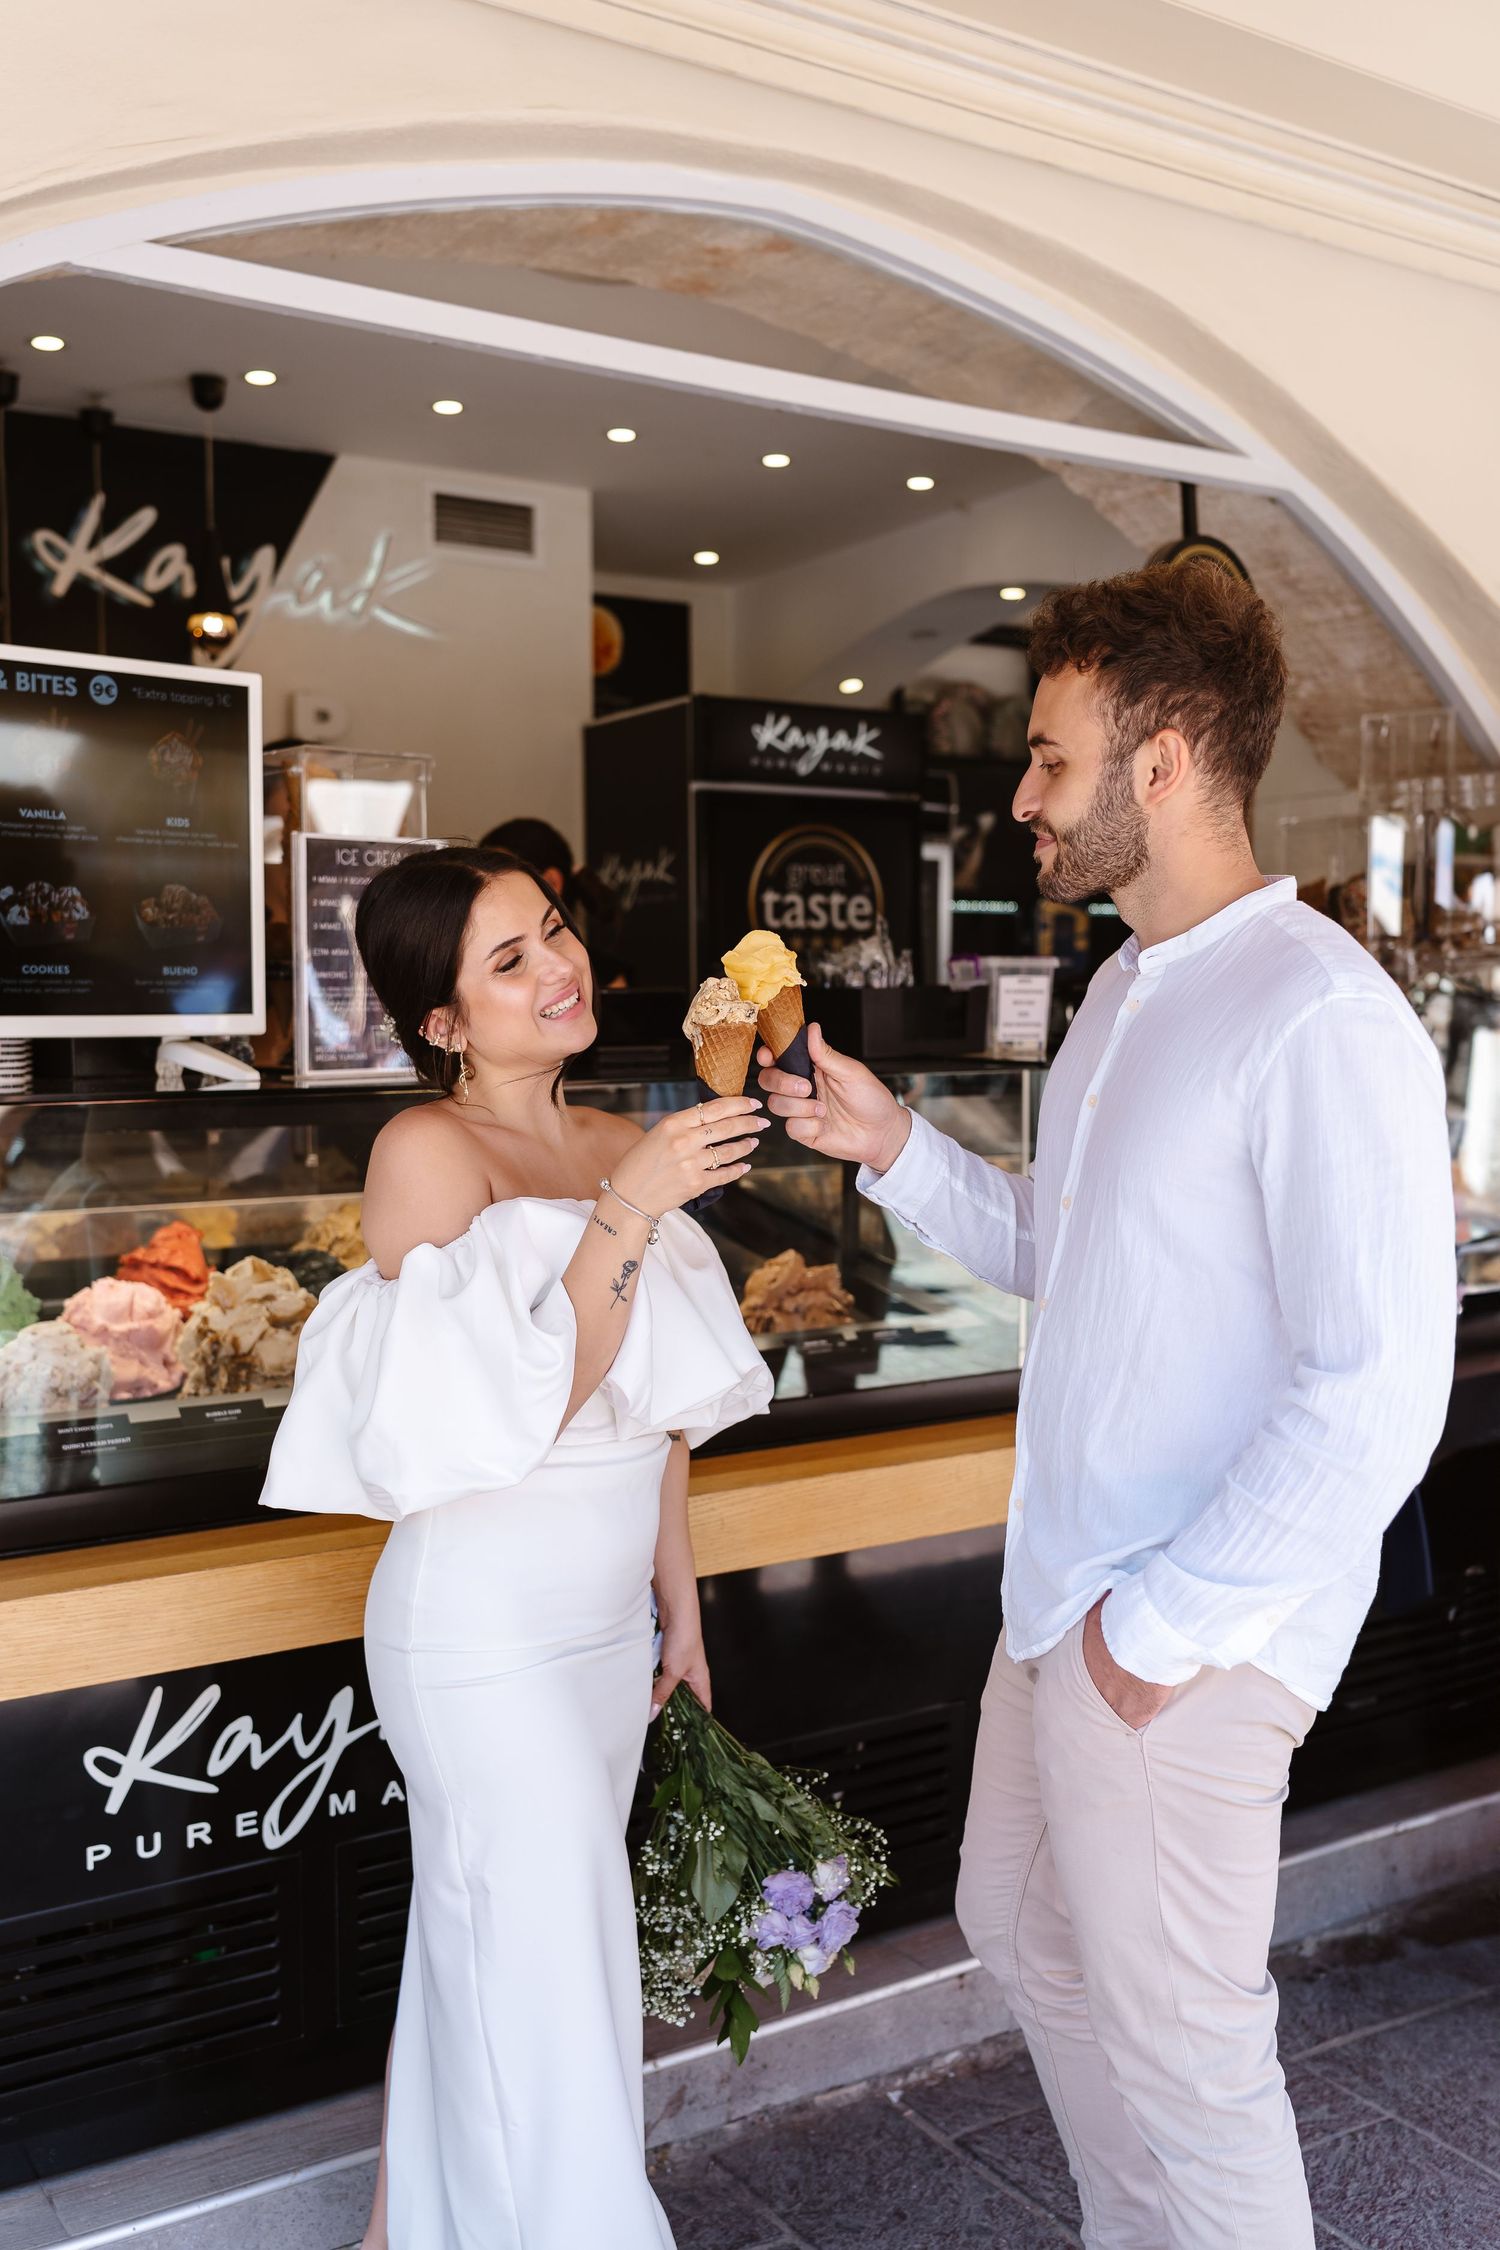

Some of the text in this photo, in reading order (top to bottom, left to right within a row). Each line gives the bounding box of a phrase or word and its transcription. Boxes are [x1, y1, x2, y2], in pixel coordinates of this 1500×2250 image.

[15, 671, 78, 697] BITES
[92, 682, 116, 698] 9€
[750, 711, 884, 776] Kayak
[19, 807, 67, 821] VANILLA
[165, 816, 191, 829] KIDS
[335, 848, 409, 867] ICE CREA
[762, 888, 873, 931] taste
[21, 963, 71, 976] COOKIES
[162, 965, 199, 976] BUENO
[83, 1684, 389, 1849] Kay
[85, 1810, 260, 1872] PURE
